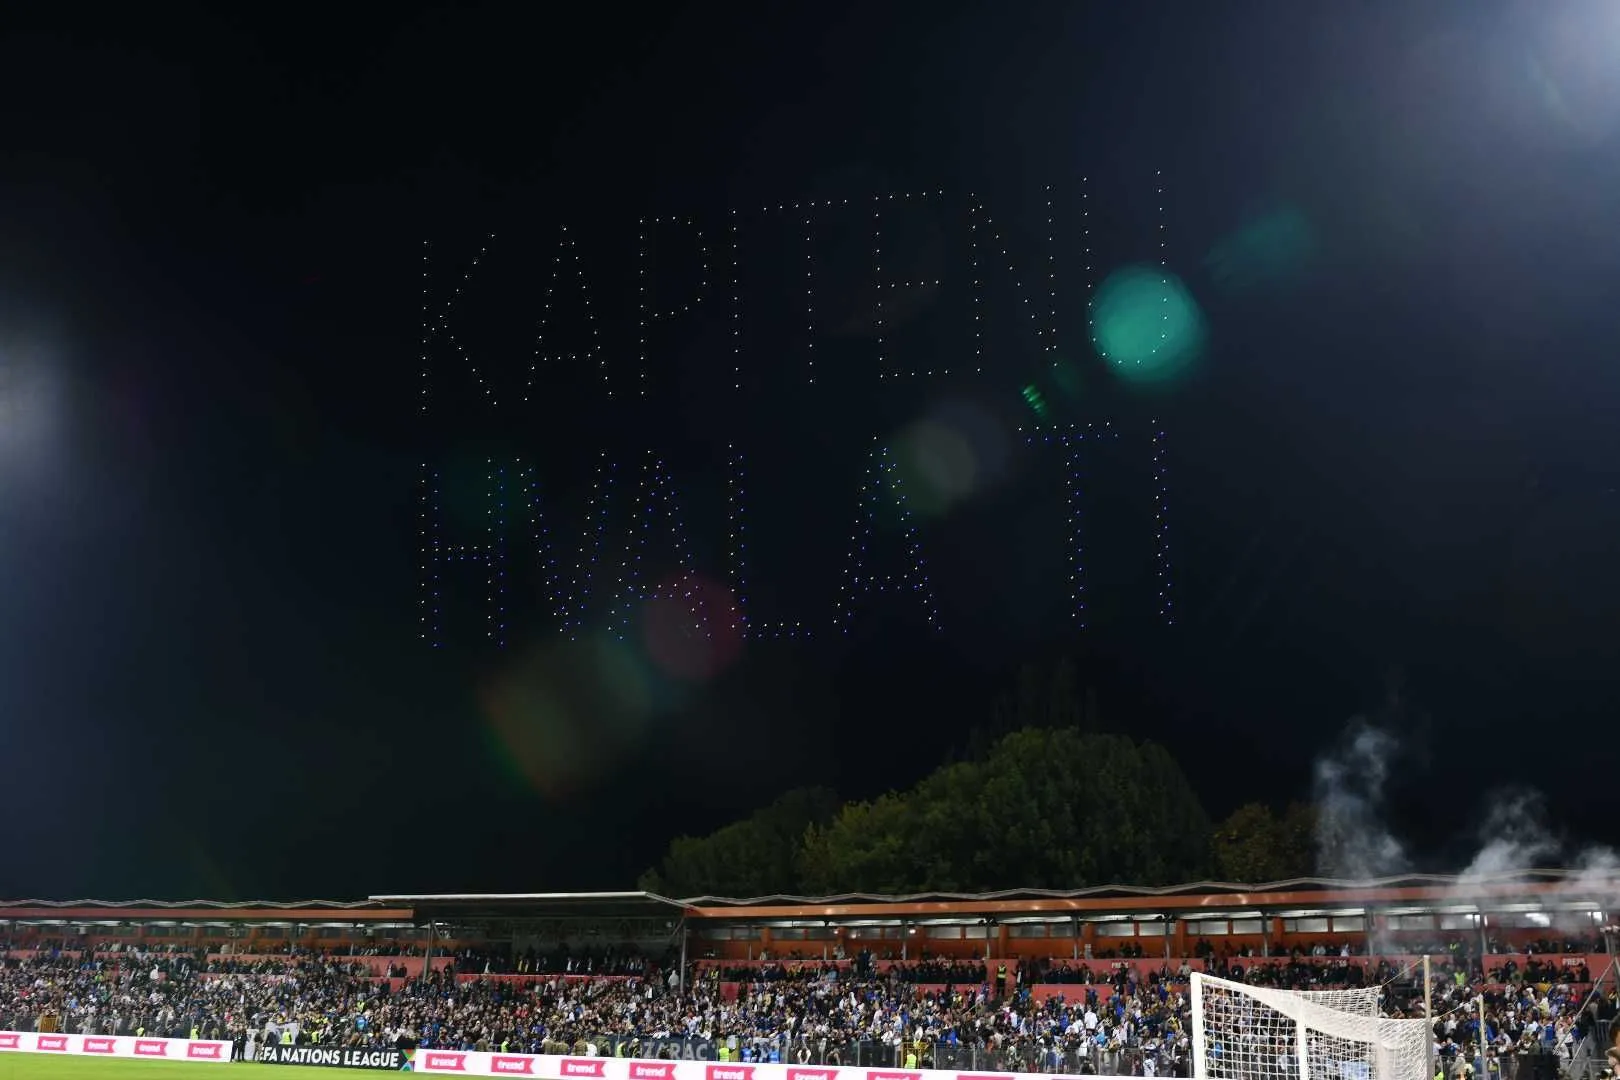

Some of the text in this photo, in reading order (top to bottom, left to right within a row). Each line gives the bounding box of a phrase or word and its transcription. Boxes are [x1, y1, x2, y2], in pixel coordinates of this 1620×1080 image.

[420, 418, 1175, 648] HVALA TI
[280, 1047, 340, 1065] NATIONS
[343, 1049, 401, 1068] LEAGUE
[567, 1063, 596, 1074] trend
[635, 1066, 666, 1077] trend
[713, 1070, 745, 1080] trend
